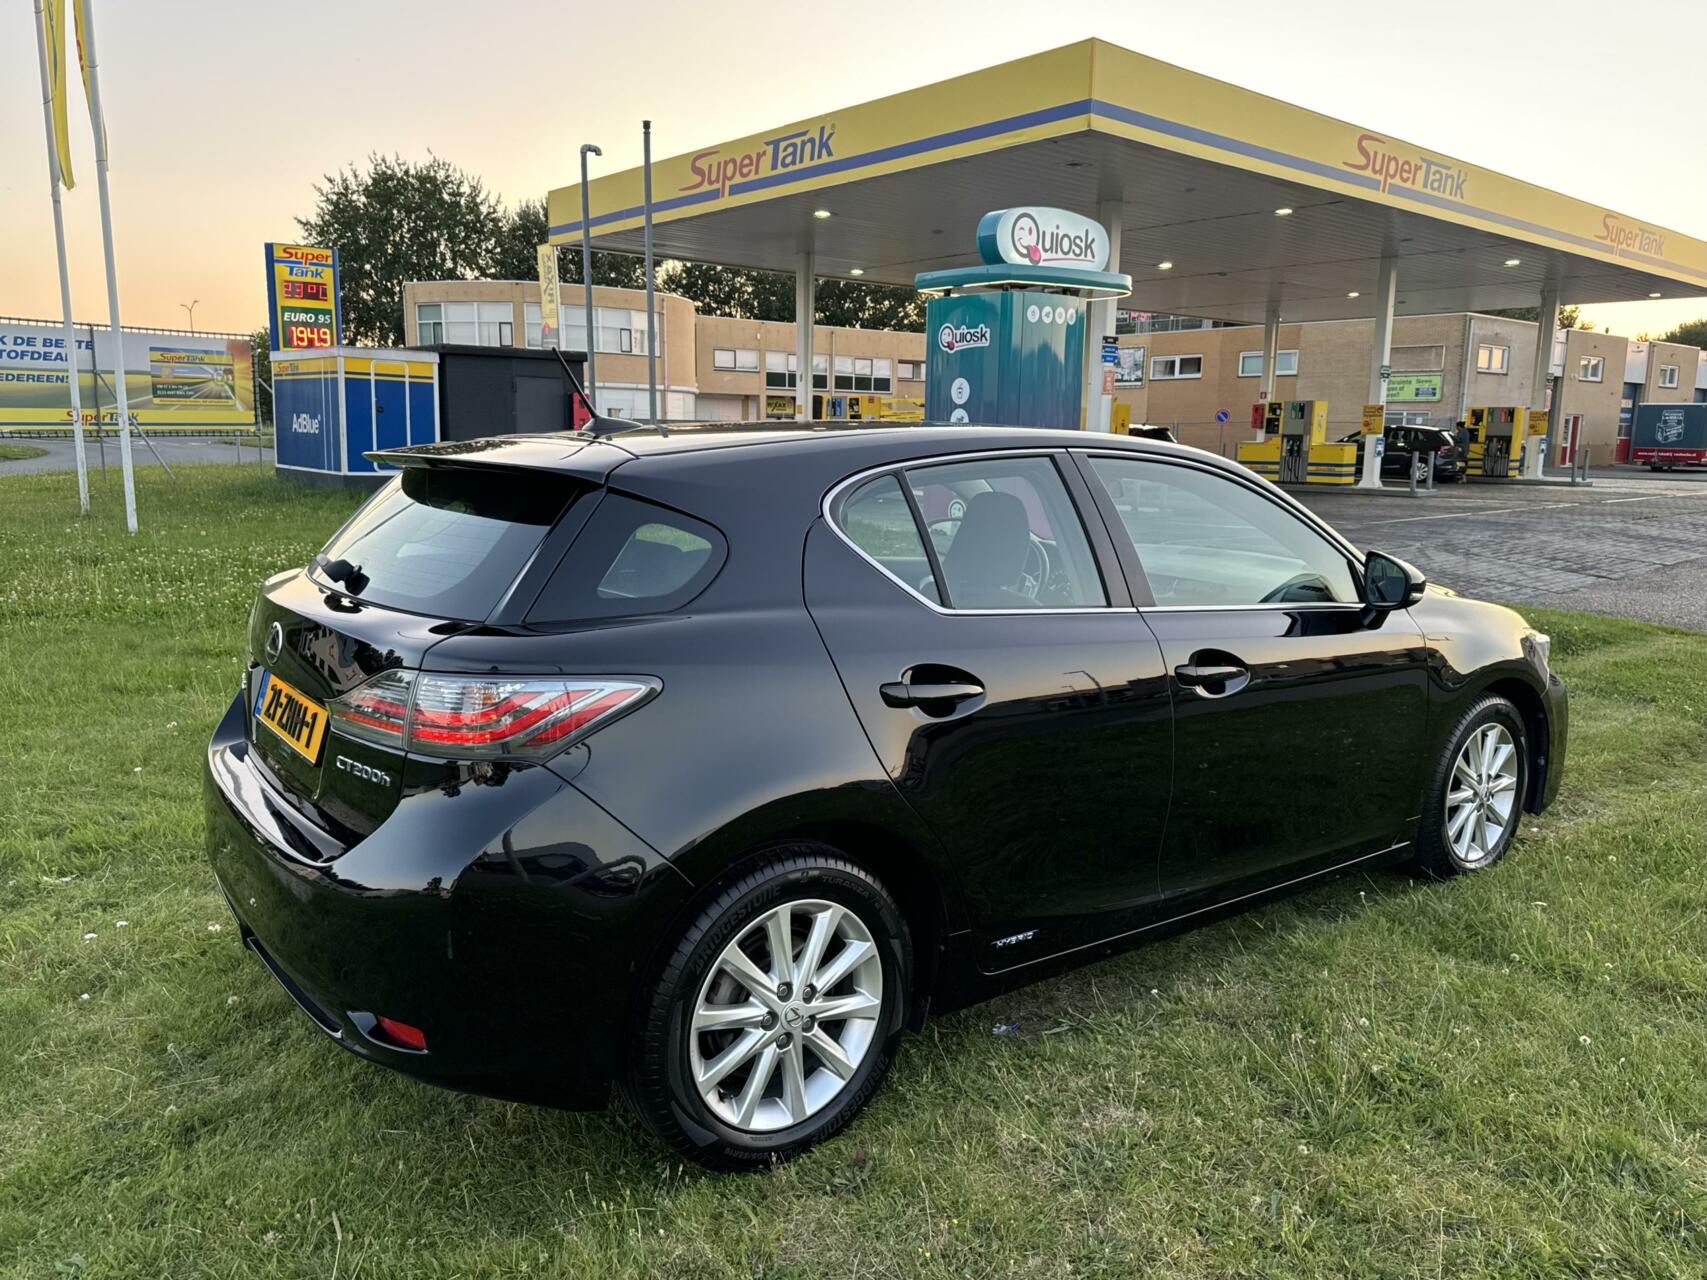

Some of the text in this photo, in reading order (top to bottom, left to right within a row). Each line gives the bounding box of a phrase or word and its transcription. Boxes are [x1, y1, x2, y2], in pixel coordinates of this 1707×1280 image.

[679, 126, 835, 198] SuperTank
[1343, 134, 1467, 199] SuperTank
[1011, 212, 1096, 265] Quiosk
[1594, 214, 1665, 256] SuperTank
[275, 247, 331, 265] Super
[284, 265, 324, 279] Tank
[284, 312, 331, 324] EURO 95
[13, 336, 37, 347] DE
[42, 338, 93, 350] BETE
[940, 325, 988, 350] Quiosk
